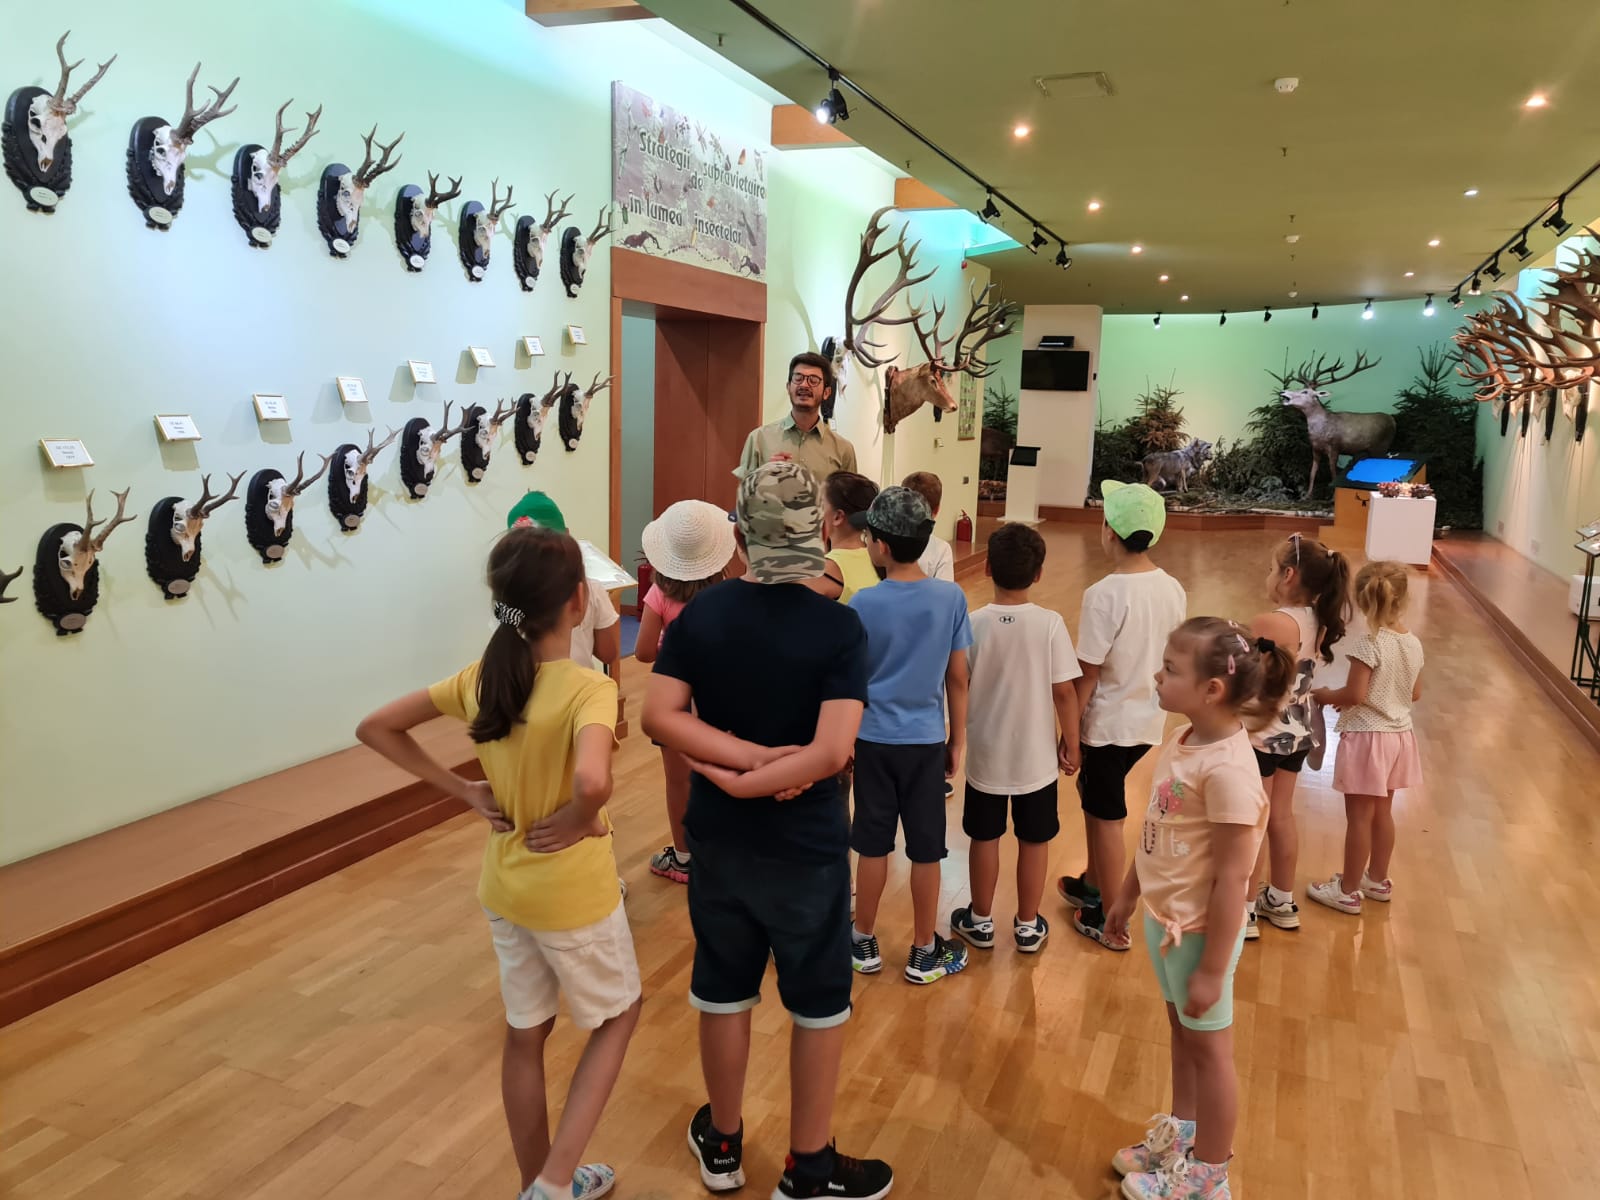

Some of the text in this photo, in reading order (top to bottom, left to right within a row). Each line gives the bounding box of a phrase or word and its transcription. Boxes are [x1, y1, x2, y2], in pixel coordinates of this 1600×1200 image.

[639, 131, 691, 171] Strategii
[691, 170, 704, 191] de
[646, 197, 683, 227] lumea
[694, 213, 742, 244] insectelor
